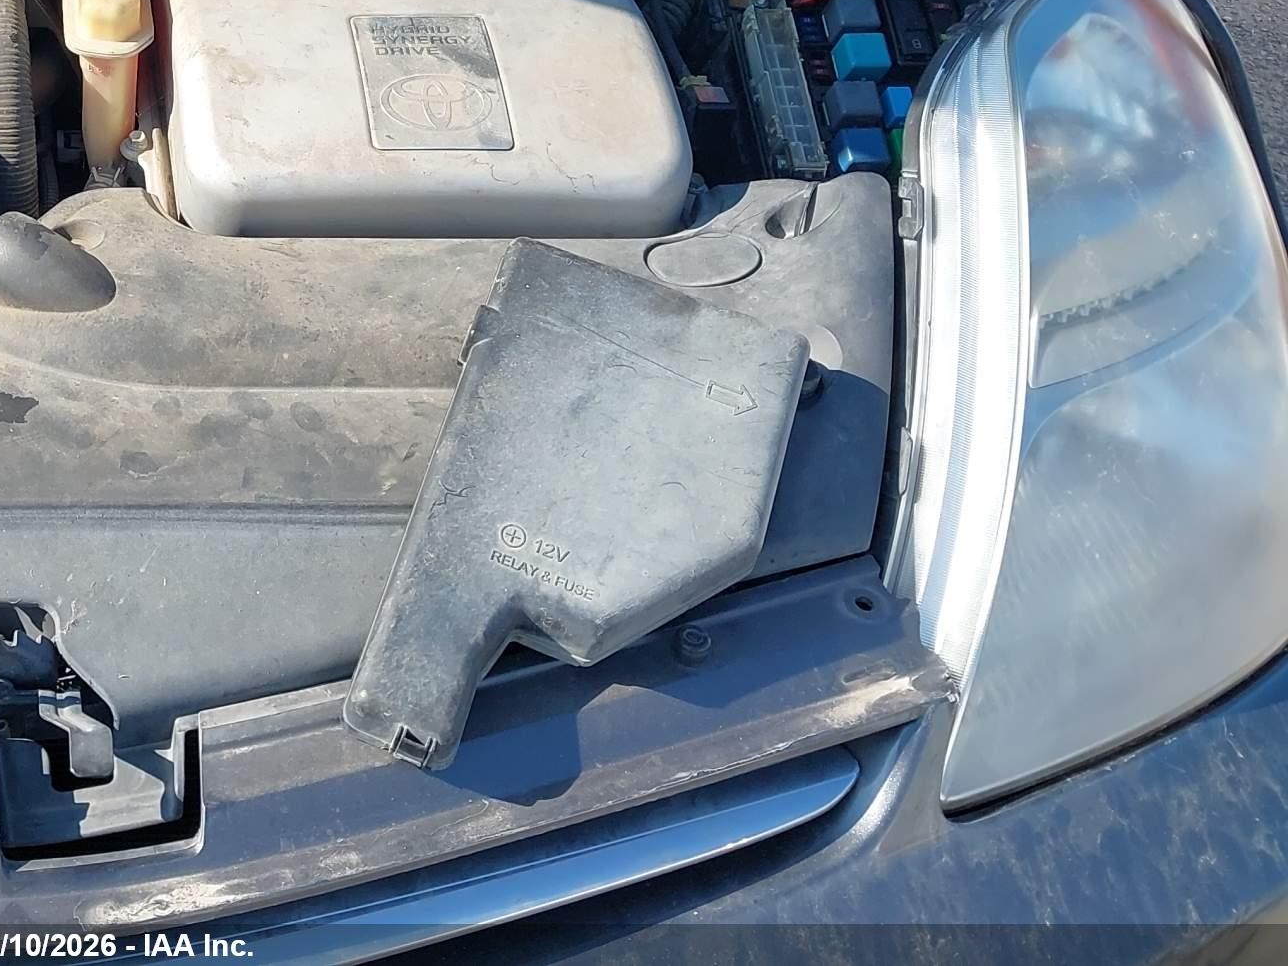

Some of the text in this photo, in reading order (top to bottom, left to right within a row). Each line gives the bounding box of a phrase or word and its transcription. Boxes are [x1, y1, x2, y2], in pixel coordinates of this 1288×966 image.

[372, 24, 450, 35] HYBRID
[373, 35, 472, 45] SYNERGY
[375, 46, 440, 56] DRIVE
[535, 538, 571, 563] 12V
[490, 550, 595, 601] RELAY & FUSE
